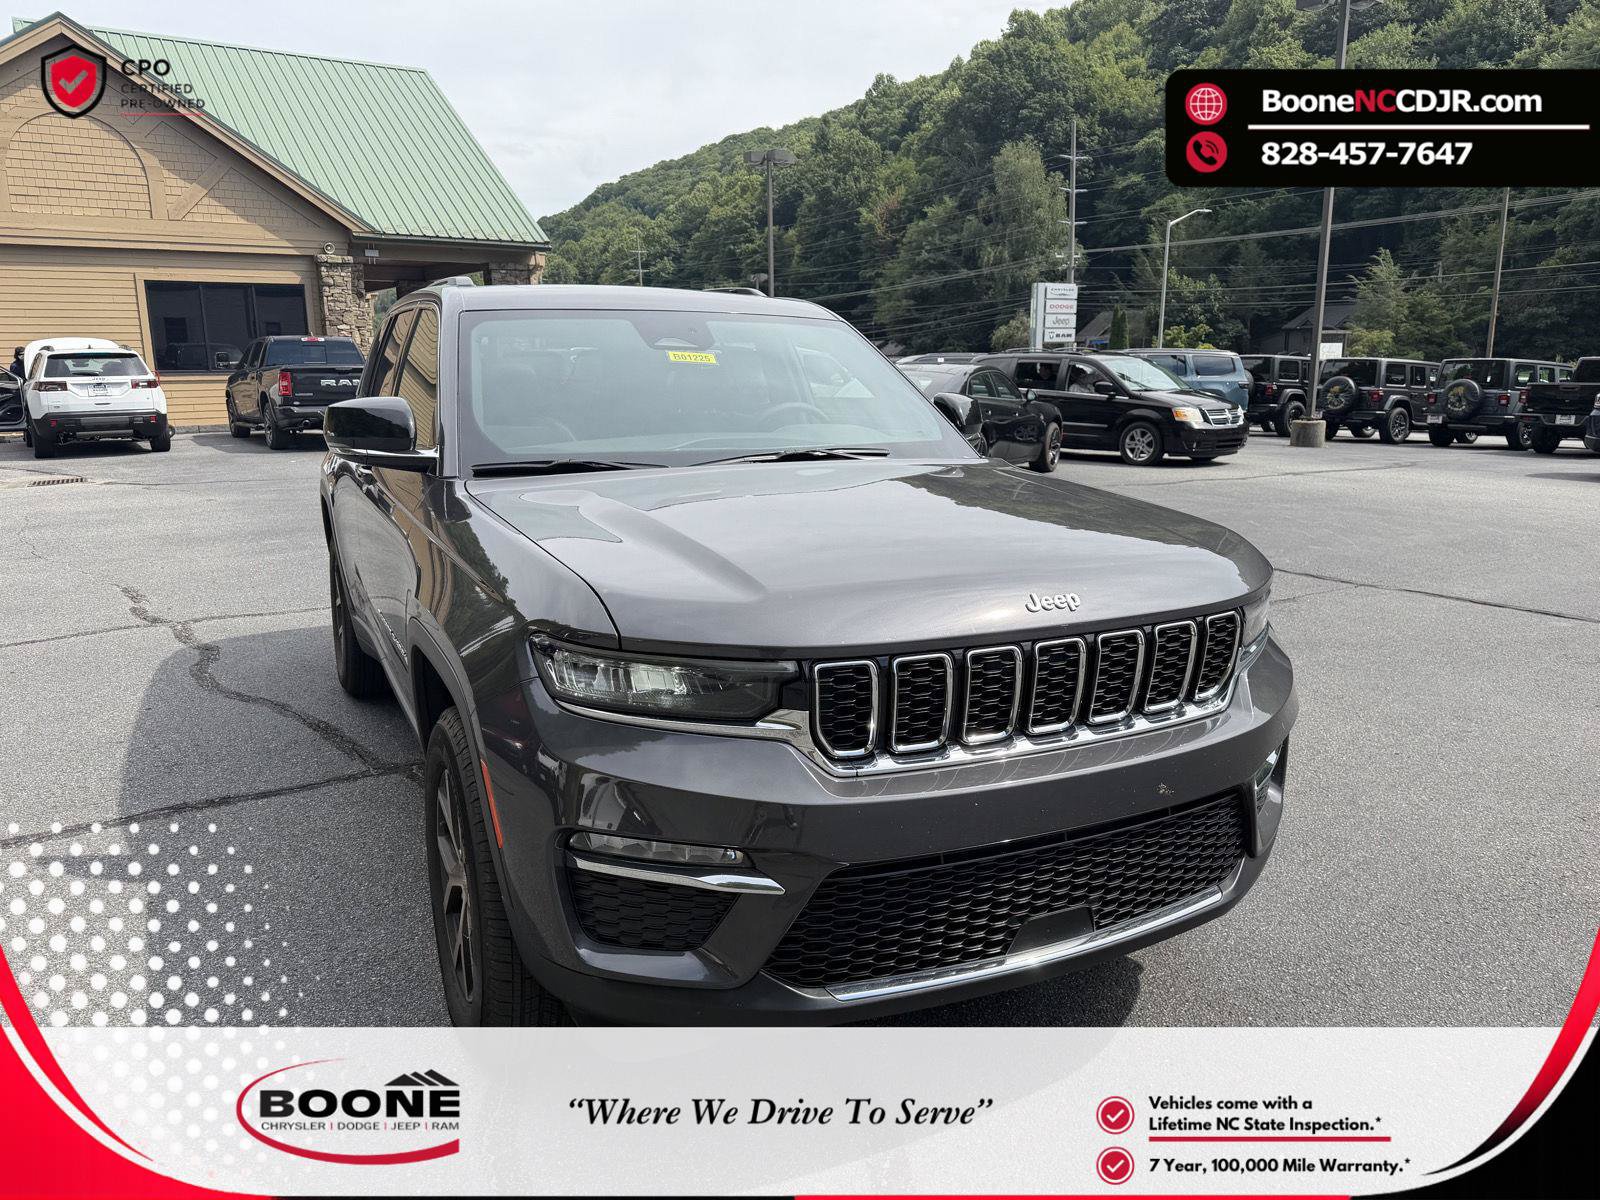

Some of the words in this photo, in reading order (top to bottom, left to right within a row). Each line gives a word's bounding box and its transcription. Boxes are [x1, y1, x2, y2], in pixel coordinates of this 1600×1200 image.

[1052, 316, 1070, 326] Jeep
[673, 353, 711, 362] B01225
[1025, 593, 1081, 613] Jeep
